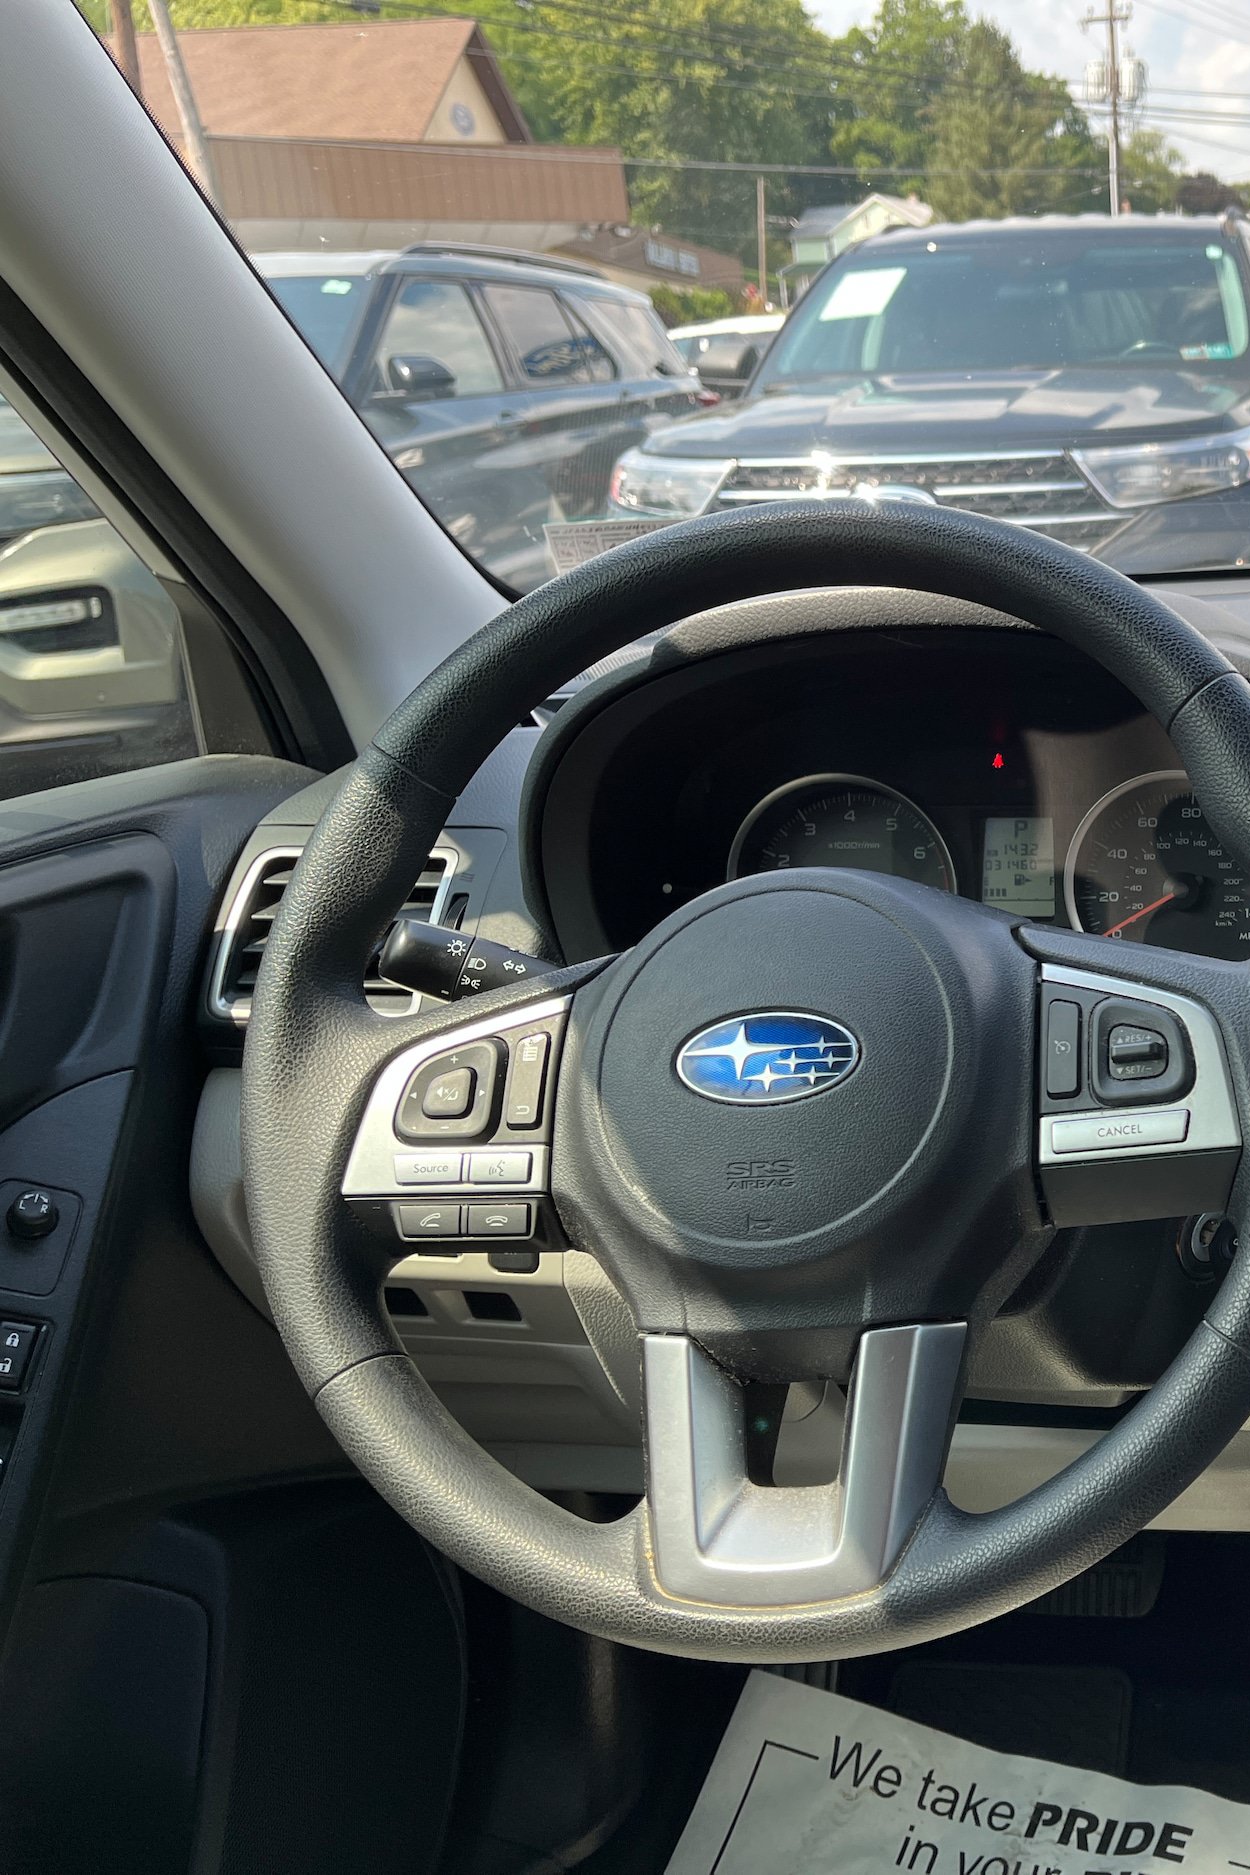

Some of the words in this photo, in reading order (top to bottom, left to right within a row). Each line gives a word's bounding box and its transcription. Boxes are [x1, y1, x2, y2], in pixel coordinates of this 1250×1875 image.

[1181, 807, 1202, 819] 80
[1137, 817, 1159, 829] 60
[1014, 820, 1029, 839] P
[1156, 842, 1171, 850] 100
[1174, 837, 1190, 846] 120
[913, 846, 927, 860] 6
[1107, 848, 1128, 860] 40
[1129, 884, 1143, 892] 40
[1099, 891, 1120, 903] 20
[1131, 902, 1144, 910] 20
[1097, 1123, 1143, 1138] CANCEL
[413, 1162, 449, 1174] Source
[726, 1159, 795, 1176] SRS
[726, 1178, 796, 1191] AIRBAG
[19, 1199, 26, 1210] L
[40, 1203, 48, 1214] R
[830, 1735, 902, 1799] We
[917, 1769, 1016, 1832] take
[1024, 1801, 1194, 1863] PRIDE
[896, 1825, 939, 1875] in
